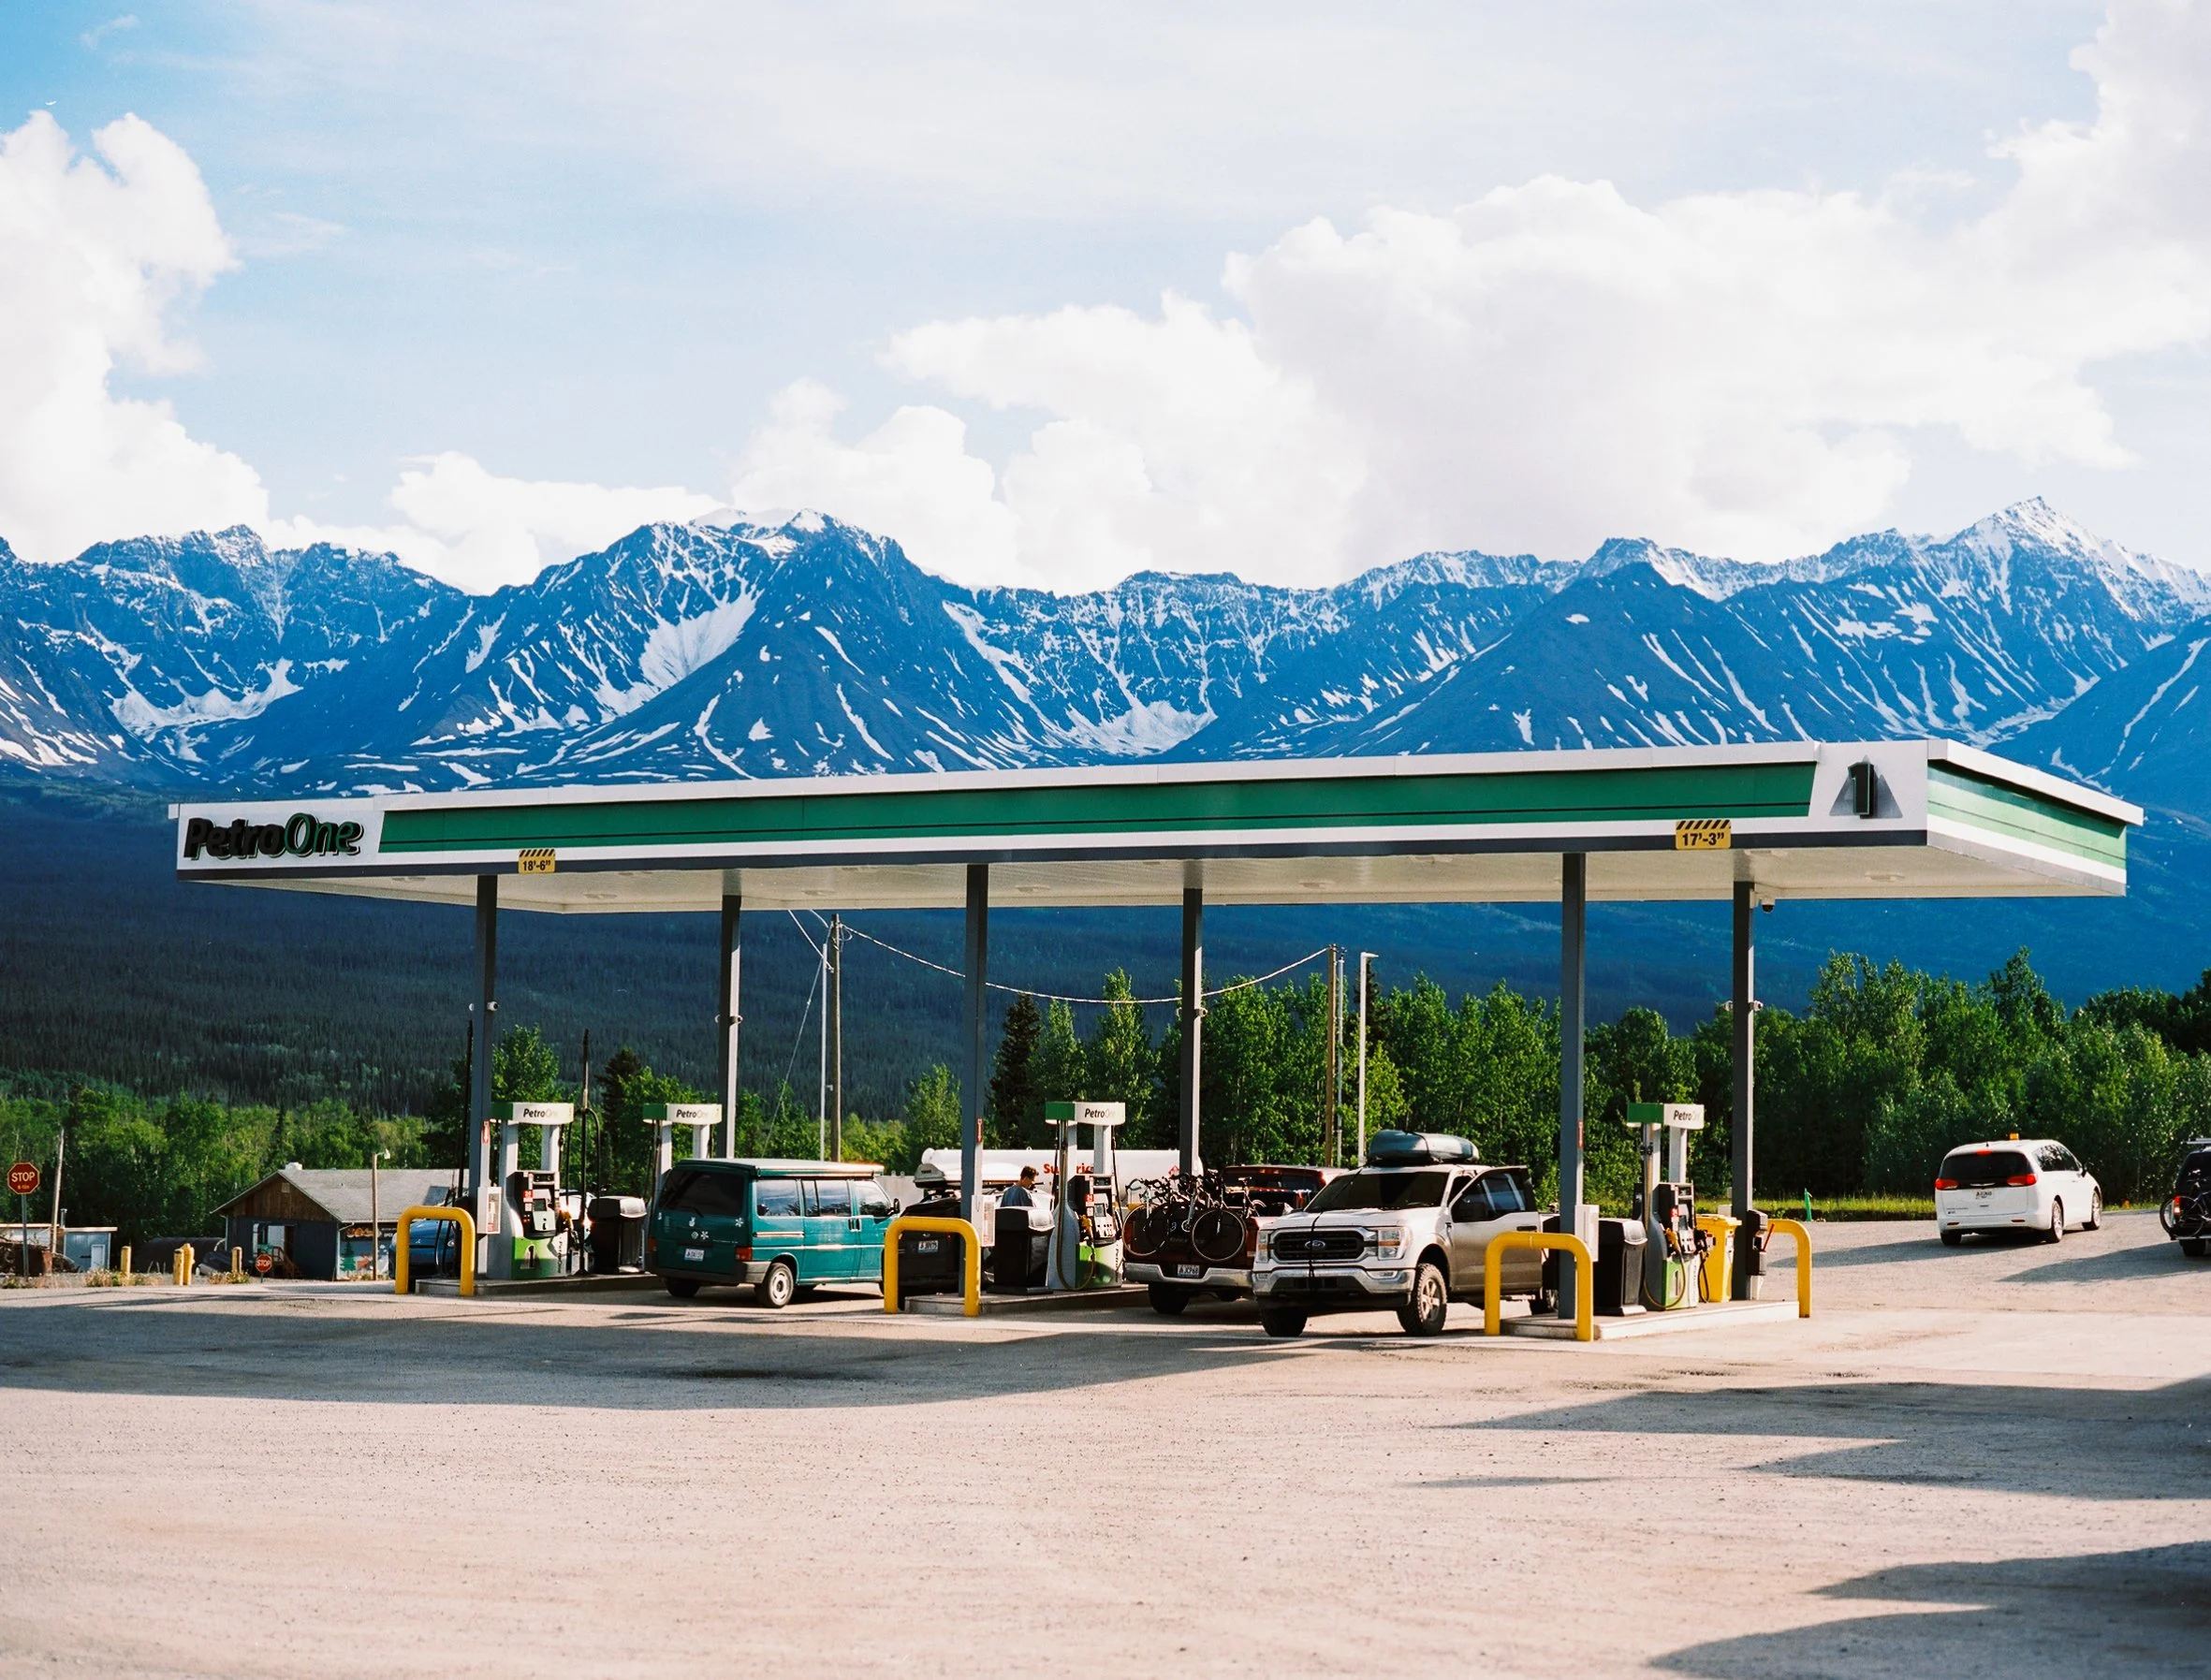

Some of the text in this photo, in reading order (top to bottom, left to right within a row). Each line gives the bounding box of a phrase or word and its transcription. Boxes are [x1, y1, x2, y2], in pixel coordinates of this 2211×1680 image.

[183, 812, 364, 860] PetroOne
[1673, 1110, 1699, 1121] Petro
[1044, 1163, 1094, 1175] Suri
[11, 1171, 36, 1182] STOP
